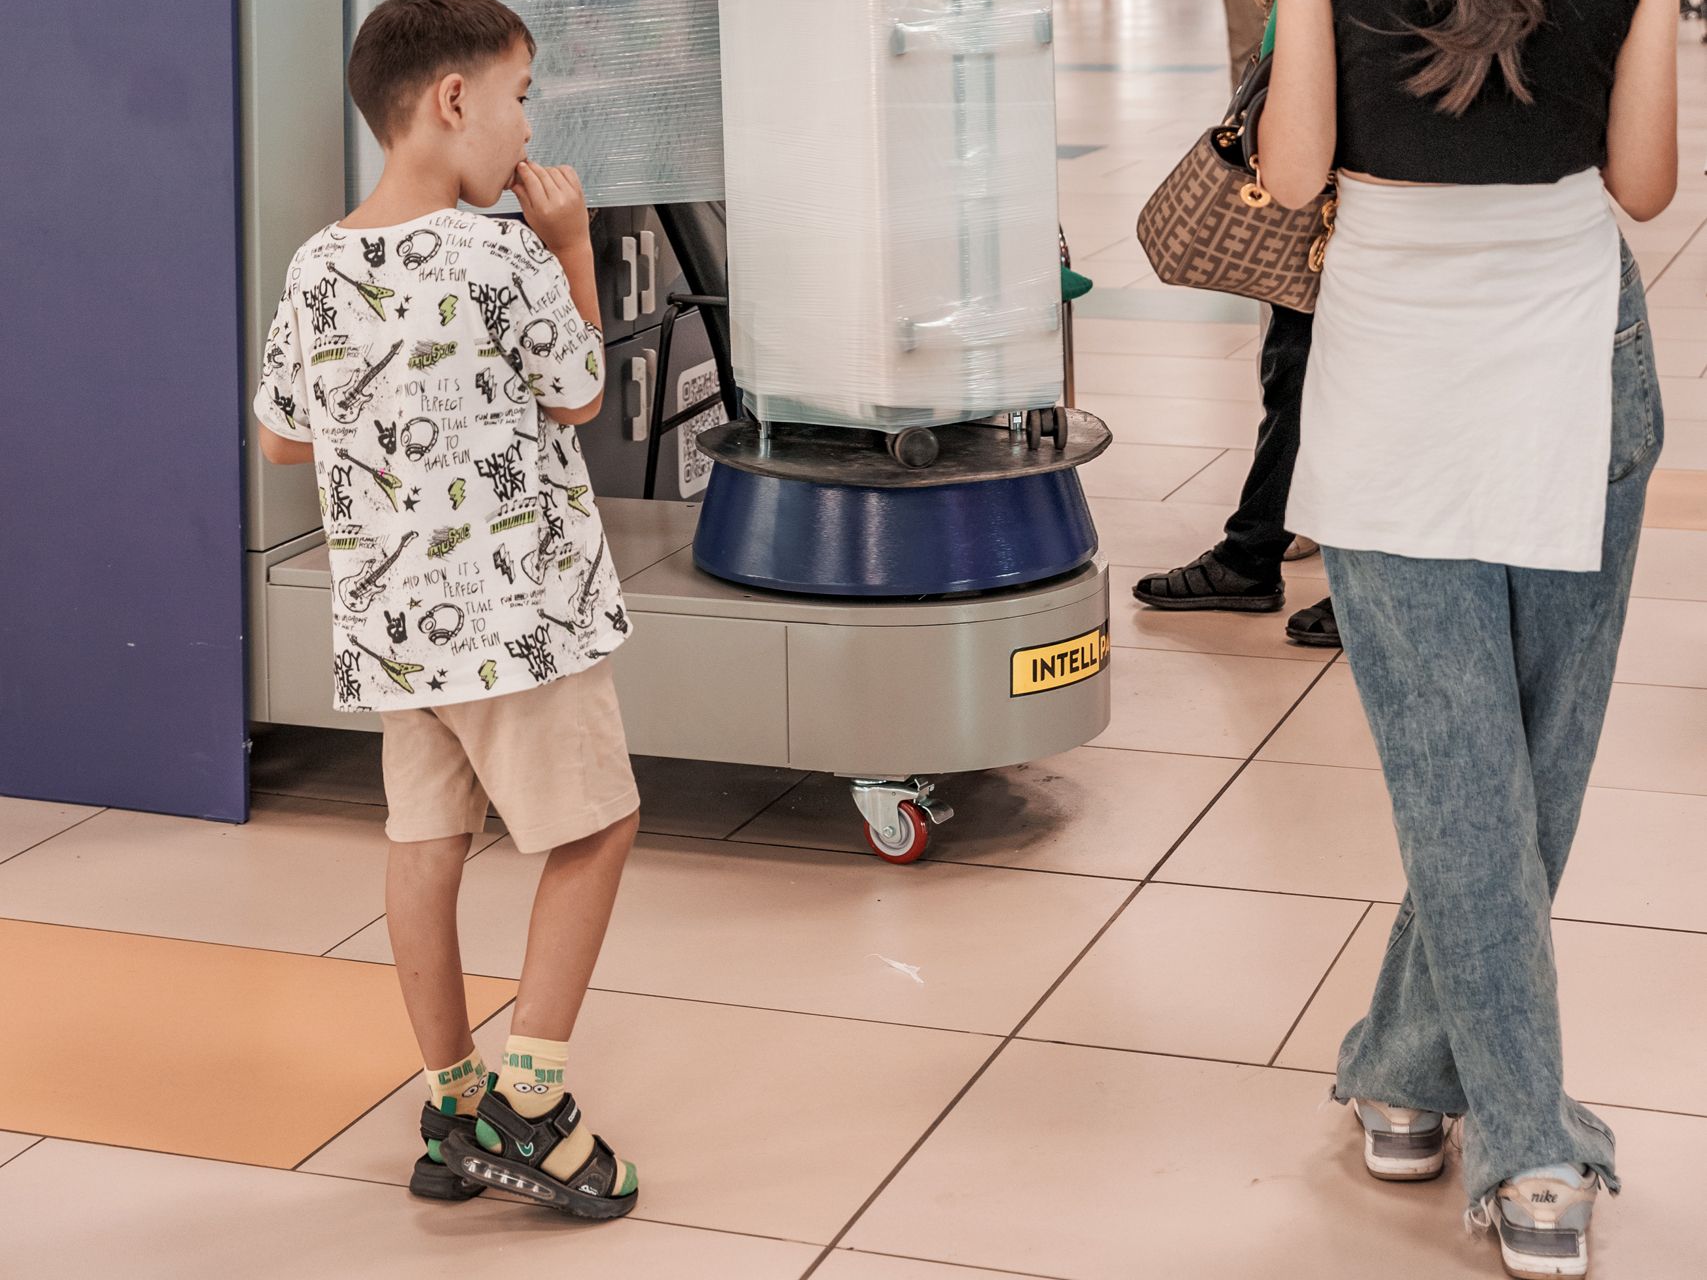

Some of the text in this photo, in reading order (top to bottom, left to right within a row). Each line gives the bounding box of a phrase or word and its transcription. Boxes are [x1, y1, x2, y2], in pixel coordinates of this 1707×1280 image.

[444, 250, 460, 266] TO
[418, 267, 468, 283] HAVE FUN
[408, 341, 458, 370] MUSIC
[421, 394, 463, 411] PERFECT
[441, 416, 468, 432] TIME
[445, 434, 459, 451] TO
[424, 448, 471, 472] HAVE FUN
[474, 439, 523, 478] ENJOY
[493, 472, 526, 502] WAY
[427, 523, 471, 559] MUSIC
[443, 579, 484, 599] PERFECT
[465, 599, 493, 615] TIME
[471, 617, 486, 634] TO
[450, 631, 501, 656] HAVE FUN
[504, 622, 551, 658] ENJOY
[528, 655, 558, 682] WAY
[1032, 642, 1098, 683] INTELL
[1531, 1190, 1558, 1204] nike
